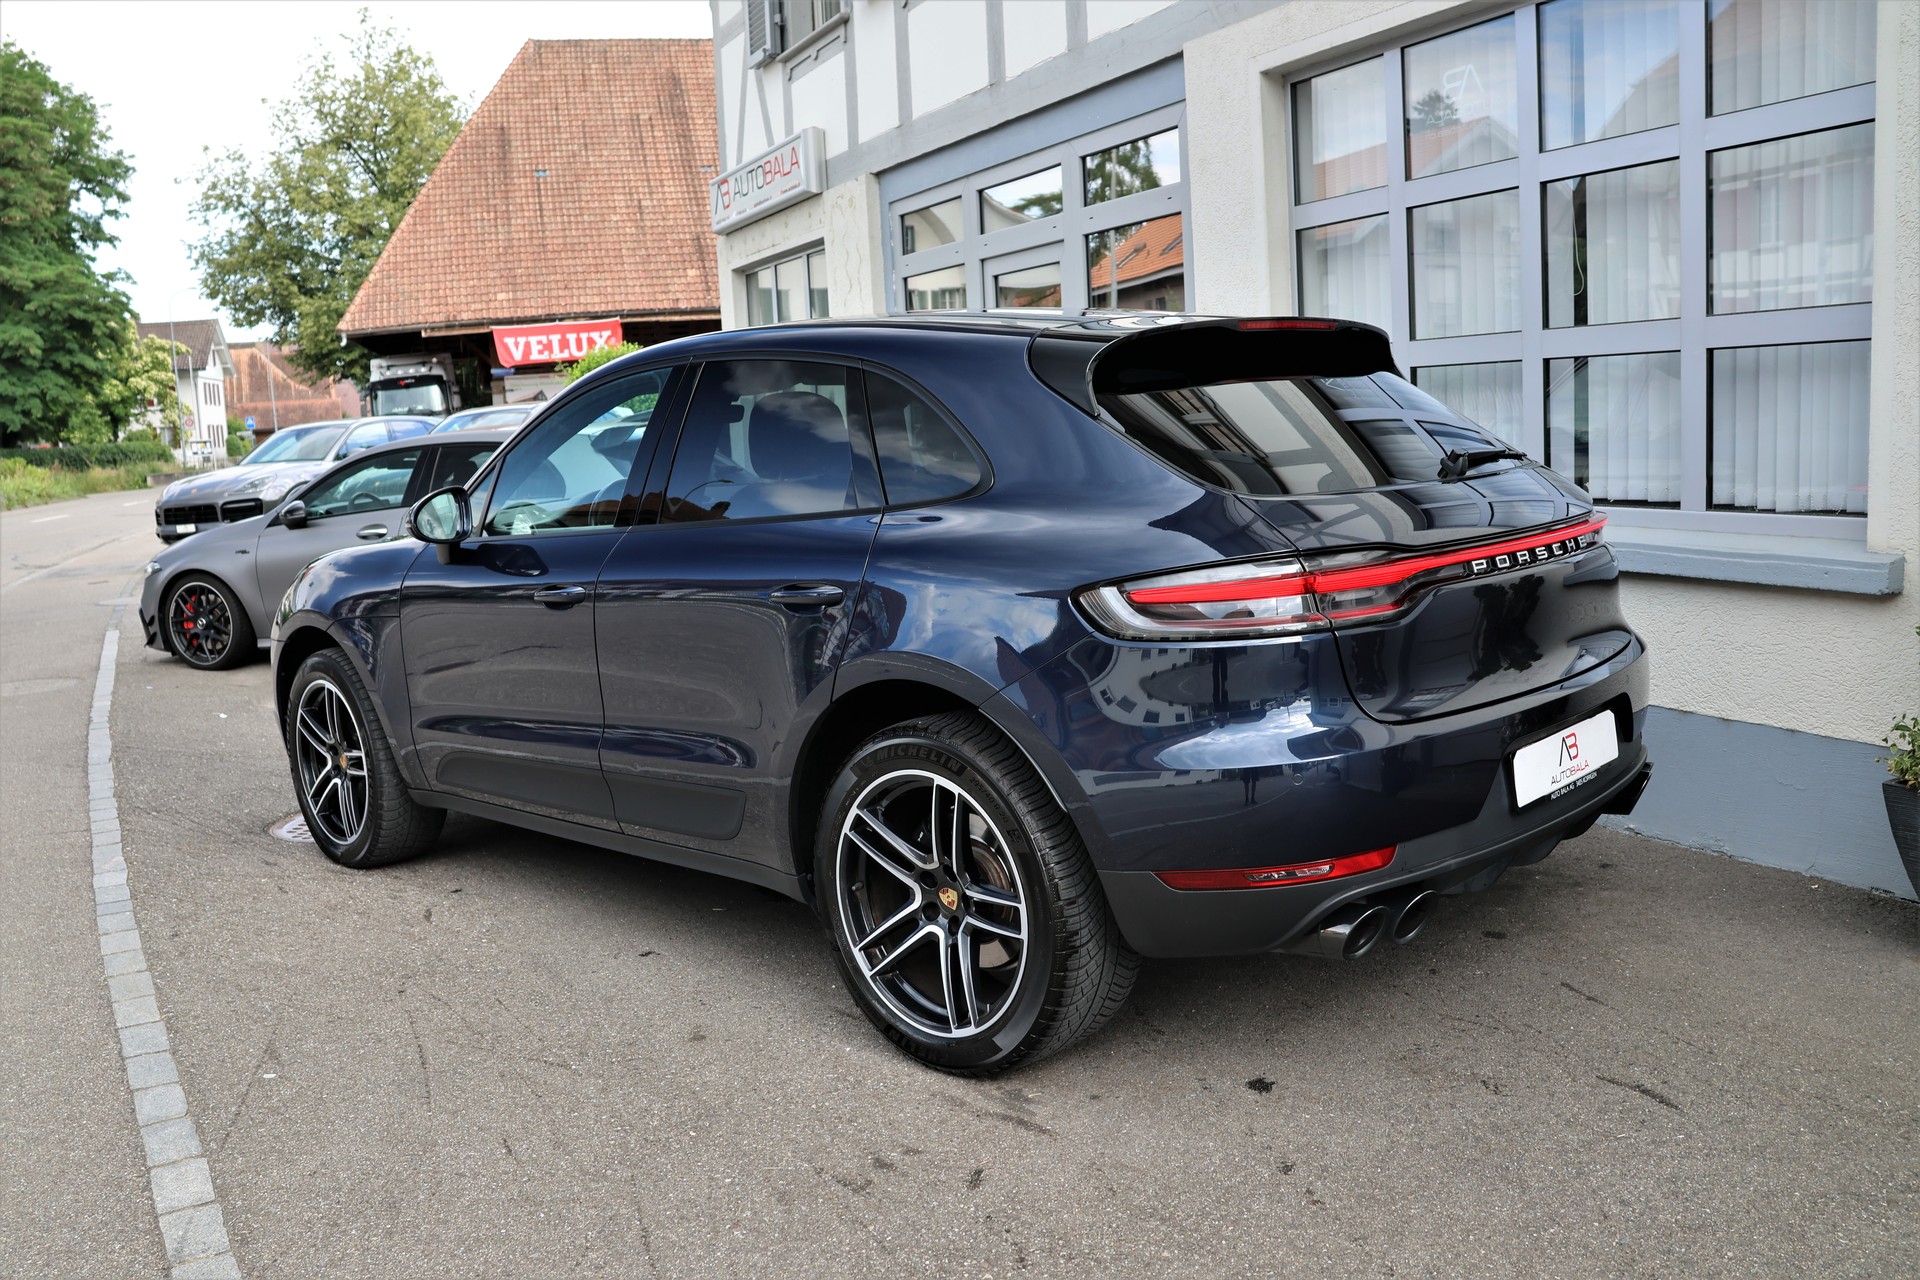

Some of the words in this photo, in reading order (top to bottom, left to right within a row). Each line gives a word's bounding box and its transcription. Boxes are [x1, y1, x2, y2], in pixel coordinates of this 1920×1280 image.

[733, 146, 800, 201] AUTOBALA
[504, 330, 611, 361] VELUX
[1472, 535, 1587, 573] PORSCHE
[877, 744, 962, 775] MICHELIN
[1551, 760, 1589, 786] AUTOBALA
